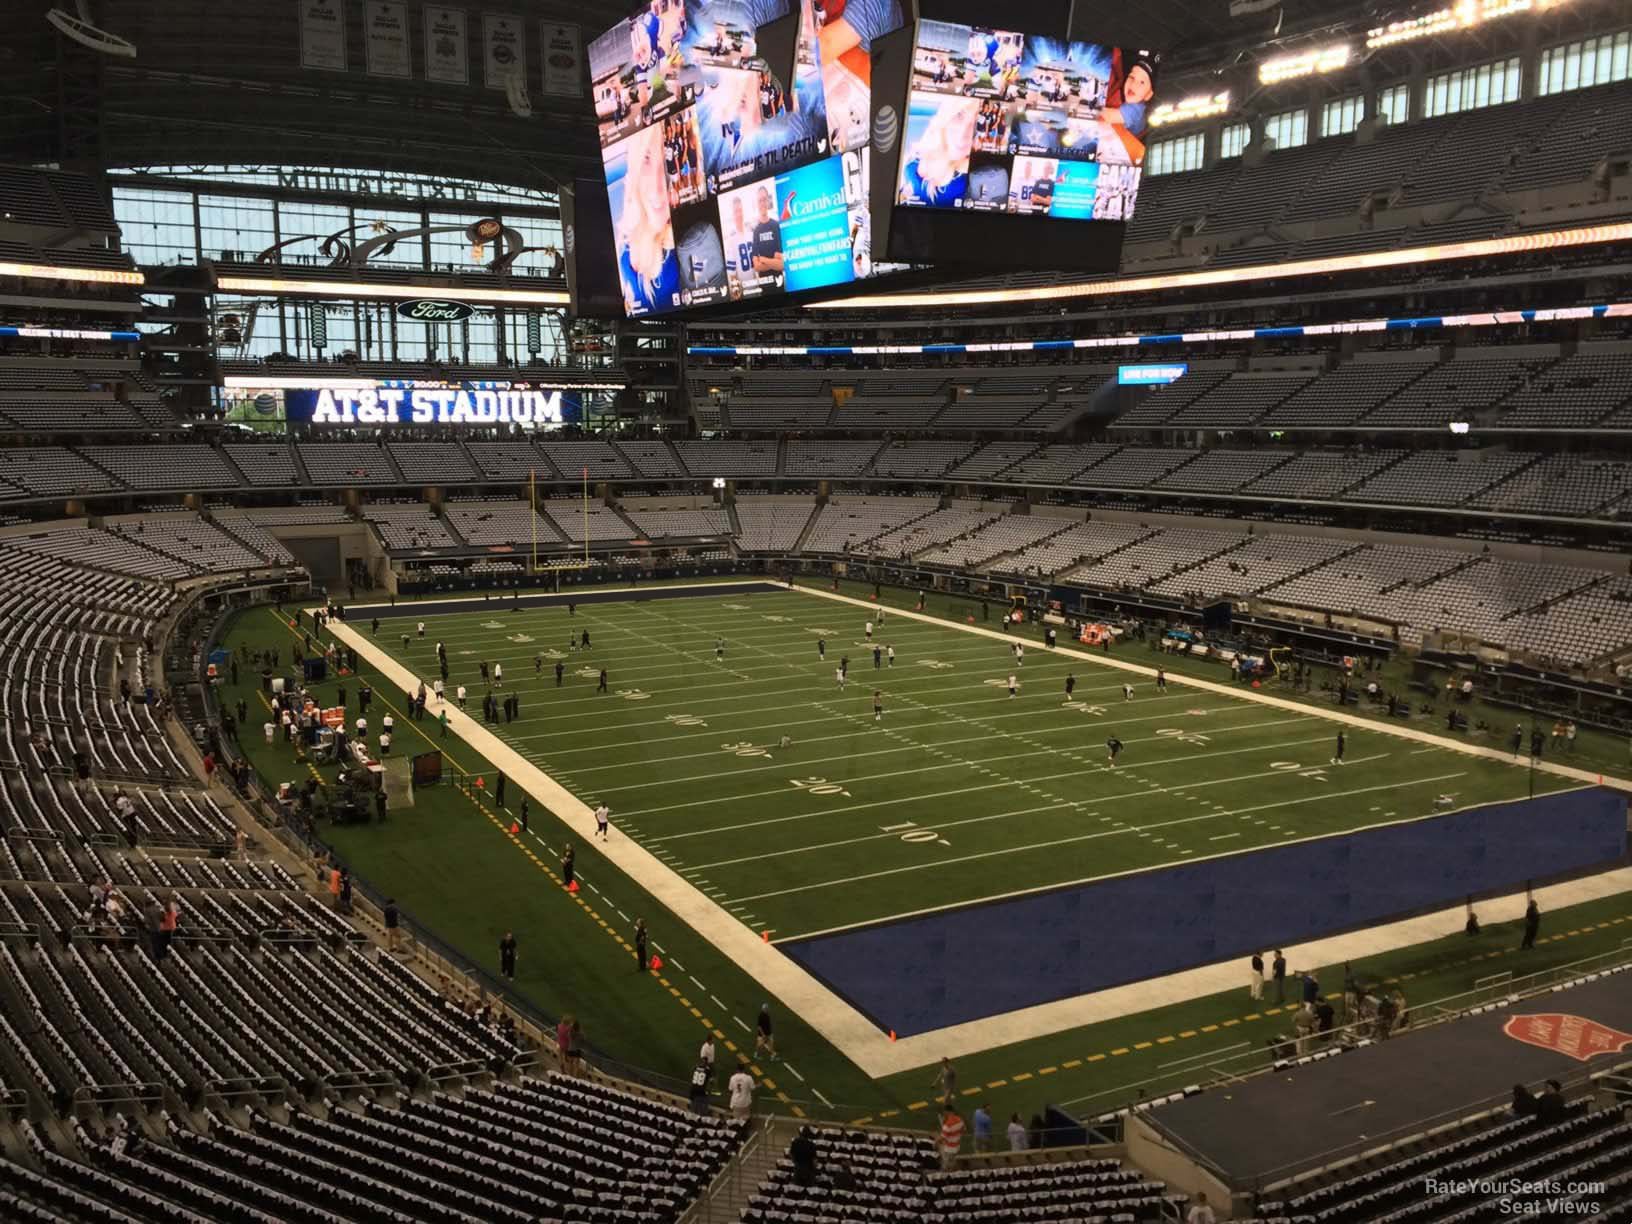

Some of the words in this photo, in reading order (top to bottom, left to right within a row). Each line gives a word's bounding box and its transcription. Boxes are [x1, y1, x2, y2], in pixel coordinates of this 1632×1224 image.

[781, 136, 816, 161] DEATH
[792, 187, 846, 217] Carnival
[411, 301, 461, 319] Ford
[312, 388, 404, 423] AT&T
[412, 389, 562, 423] STADIUM
[789, 775, 843, 795] 20
[876, 820, 939, 843] 10
